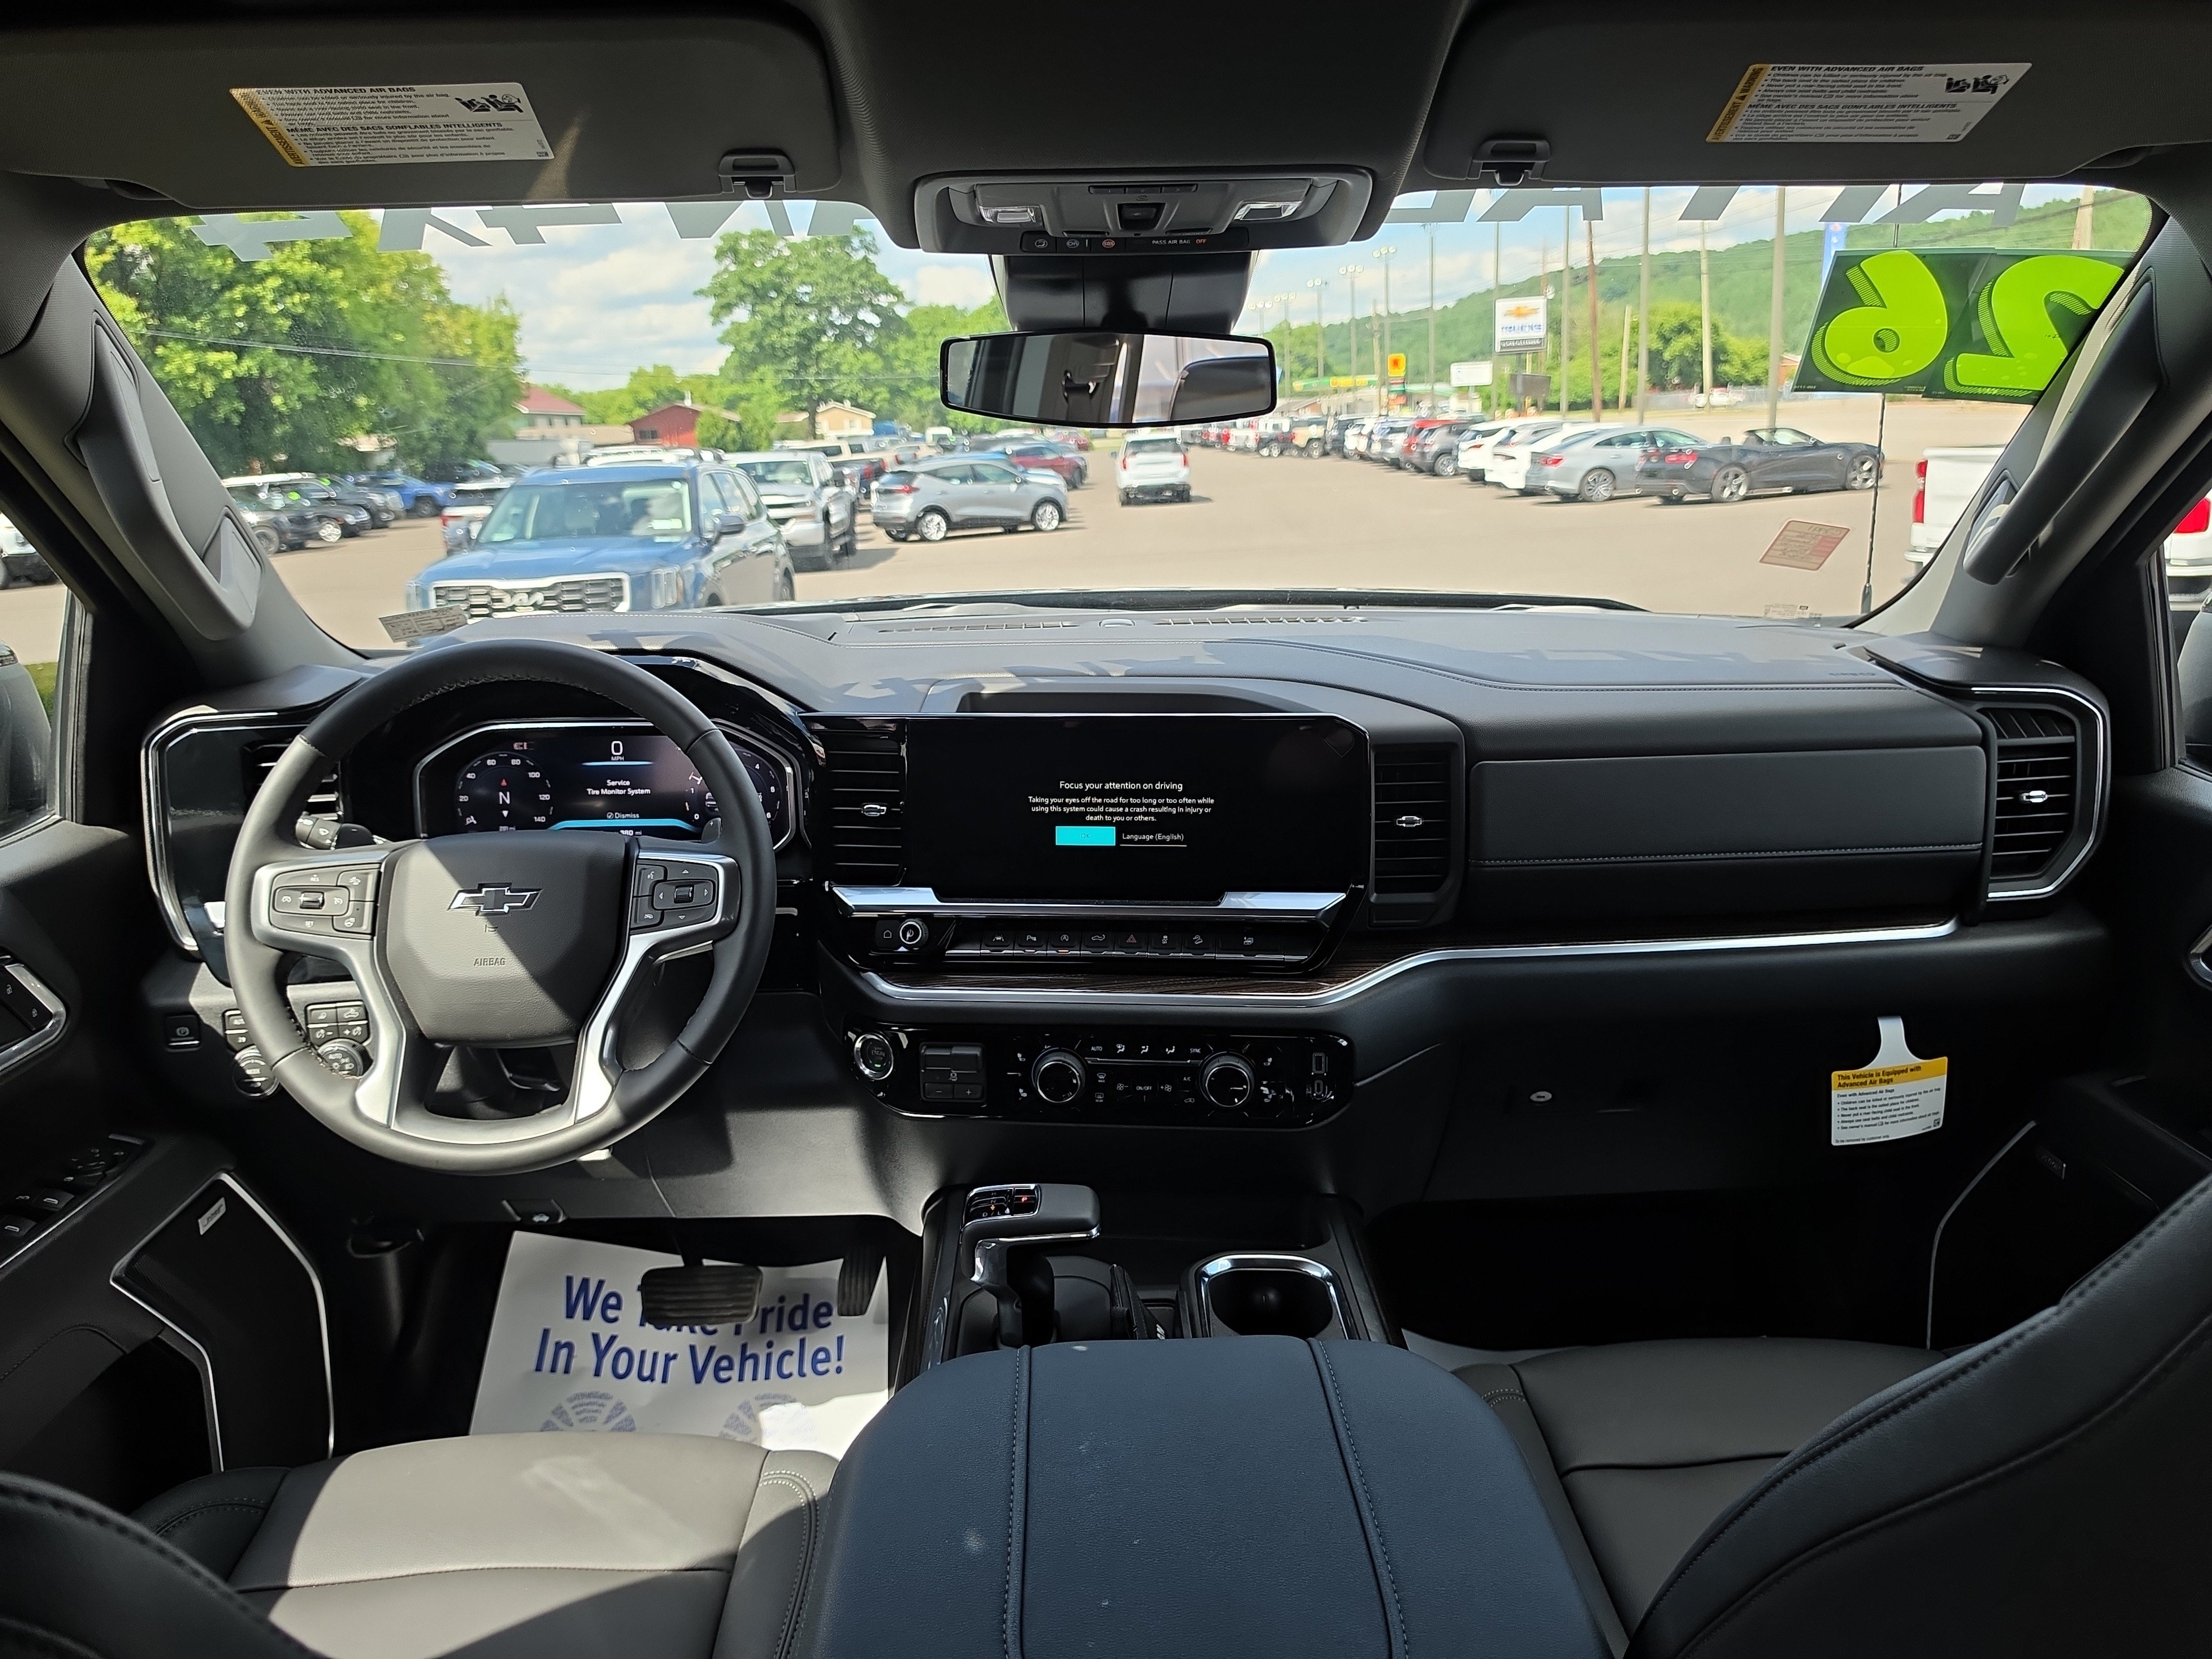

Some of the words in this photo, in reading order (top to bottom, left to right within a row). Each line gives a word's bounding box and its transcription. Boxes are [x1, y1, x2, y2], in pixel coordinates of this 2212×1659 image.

[1741, 68, 1763, 93] WARNING
[610, 741, 623, 755] 0
[627, 788, 651, 796] System
[1059, 781, 1083, 789] Focus
[1085, 783, 1103, 791] your
[1104, 781, 1141, 789] attention
[1155, 781, 1183, 792] driving
[499, 791, 510, 805] N
[1148, 806, 1176, 814] resulting
[1185, 806, 1203, 814] injury
[1155, 833, 1184, 841] (English)
[474, 957, 505, 966] AIRBAG
[1882, 1067, 1908, 1077] Equipped
[564, 1275, 623, 1323] We
[734, 1293, 833, 1337] ride
[533, 1328, 575, 1374] In
[590, 1332, 678, 1385] Your
[689, 1334, 845, 1385] Vehicle!
